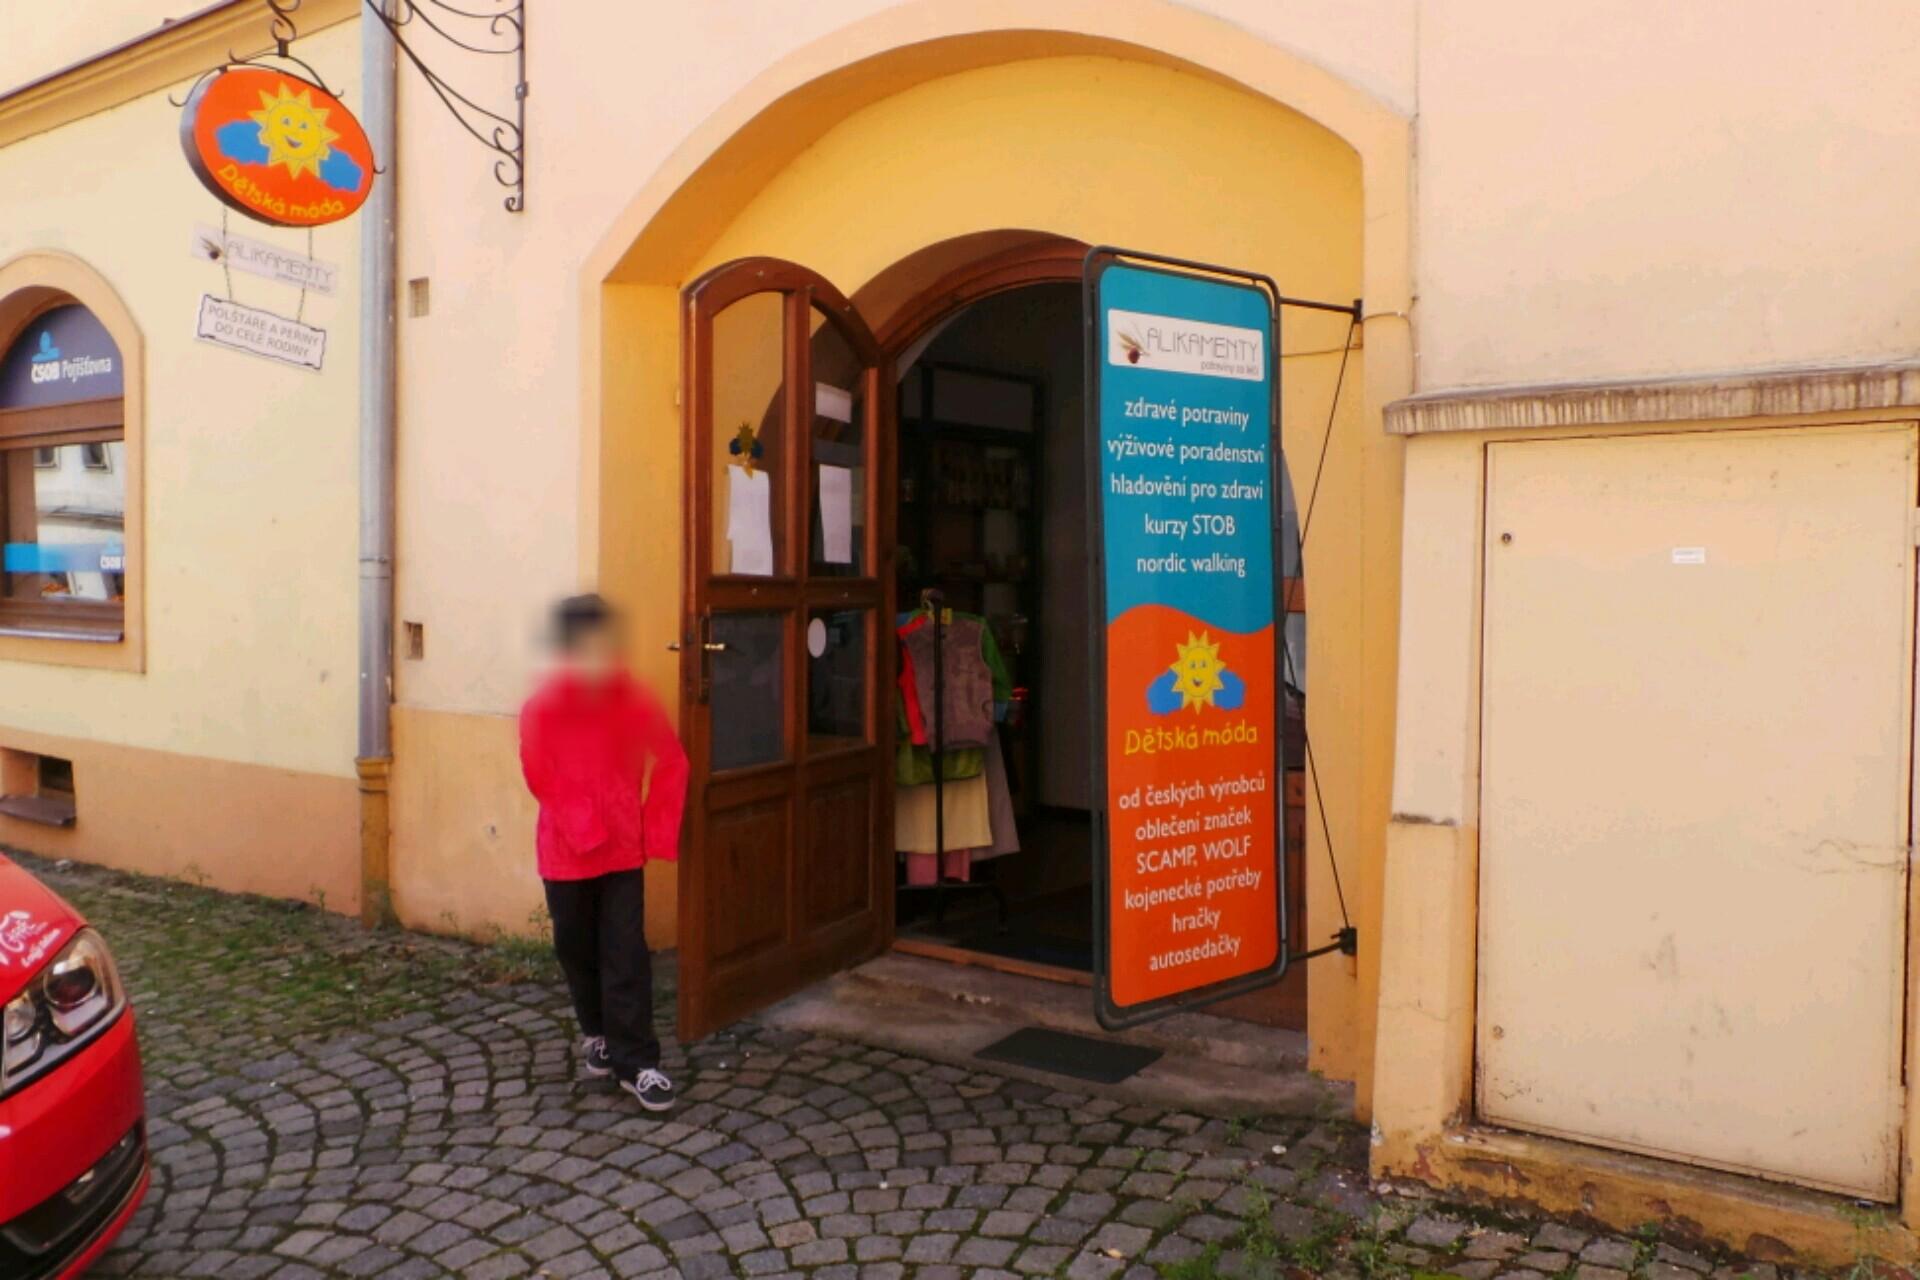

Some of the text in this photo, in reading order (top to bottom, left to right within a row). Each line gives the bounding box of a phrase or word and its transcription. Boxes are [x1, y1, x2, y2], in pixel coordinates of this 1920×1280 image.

[290, 197, 346, 218] móda
[227, 241, 332, 282] ALIKAMENTY
[214, 321, 233, 336] DO
[1147, 327, 1258, 362] ALIKAMENTY
[1124, 398, 1250, 431] zdravé potraviny
[1107, 433, 1265, 465] výživové poradenství
[1110, 473, 1264, 502] hladovění pro zdraví
[1144, 513, 1236, 541] kurzy STOB
[1136, 553, 1246, 578] nordic walking
[1124, 719, 1258, 756] Dětská móda
[1118, 770, 1266, 810] od českých výrobců
[1135, 805, 1253, 842] oblečení značek
[1202, 835, 1253, 861] WOLF
[1124, 868, 1263, 912] kojenecké potřeby
[1172, 906, 1221, 934] hračky
[1149, 935, 1241, 972] autosedačky
